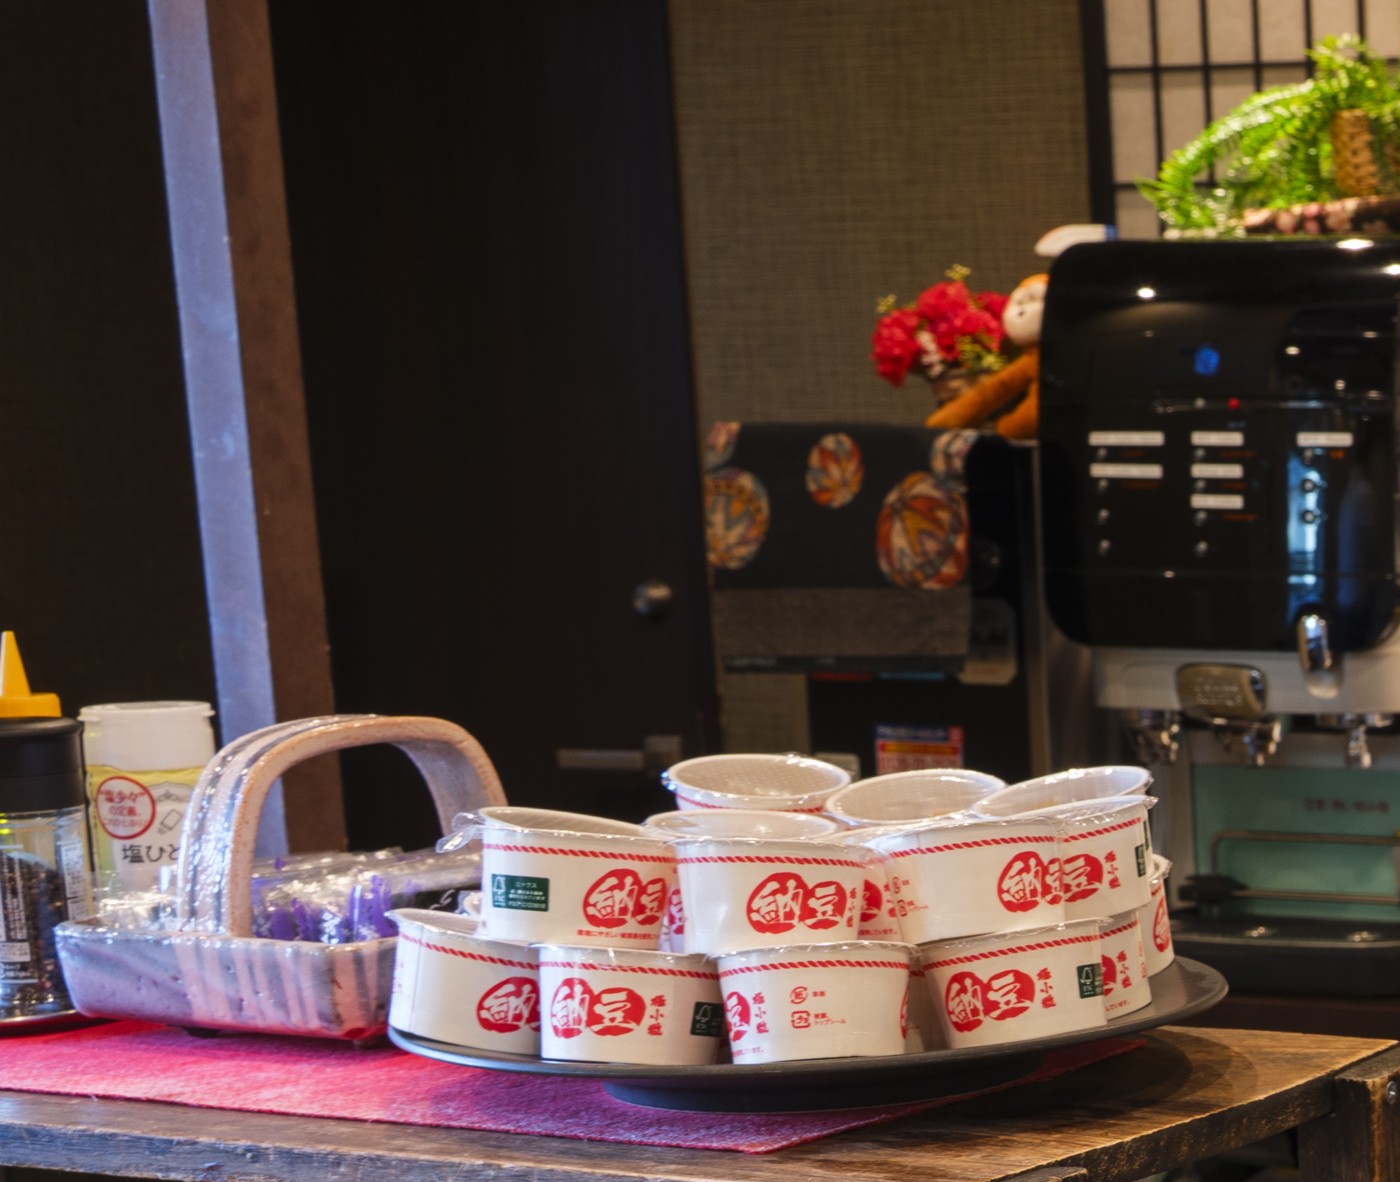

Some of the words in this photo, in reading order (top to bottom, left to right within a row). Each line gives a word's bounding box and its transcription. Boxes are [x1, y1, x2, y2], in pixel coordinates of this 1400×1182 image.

[584, 870, 666, 927] 納豆
[746, 873, 847, 933] 納豆
[552, 978, 646, 1038] 納豆
[946, 970, 1035, 1033] 納豆
